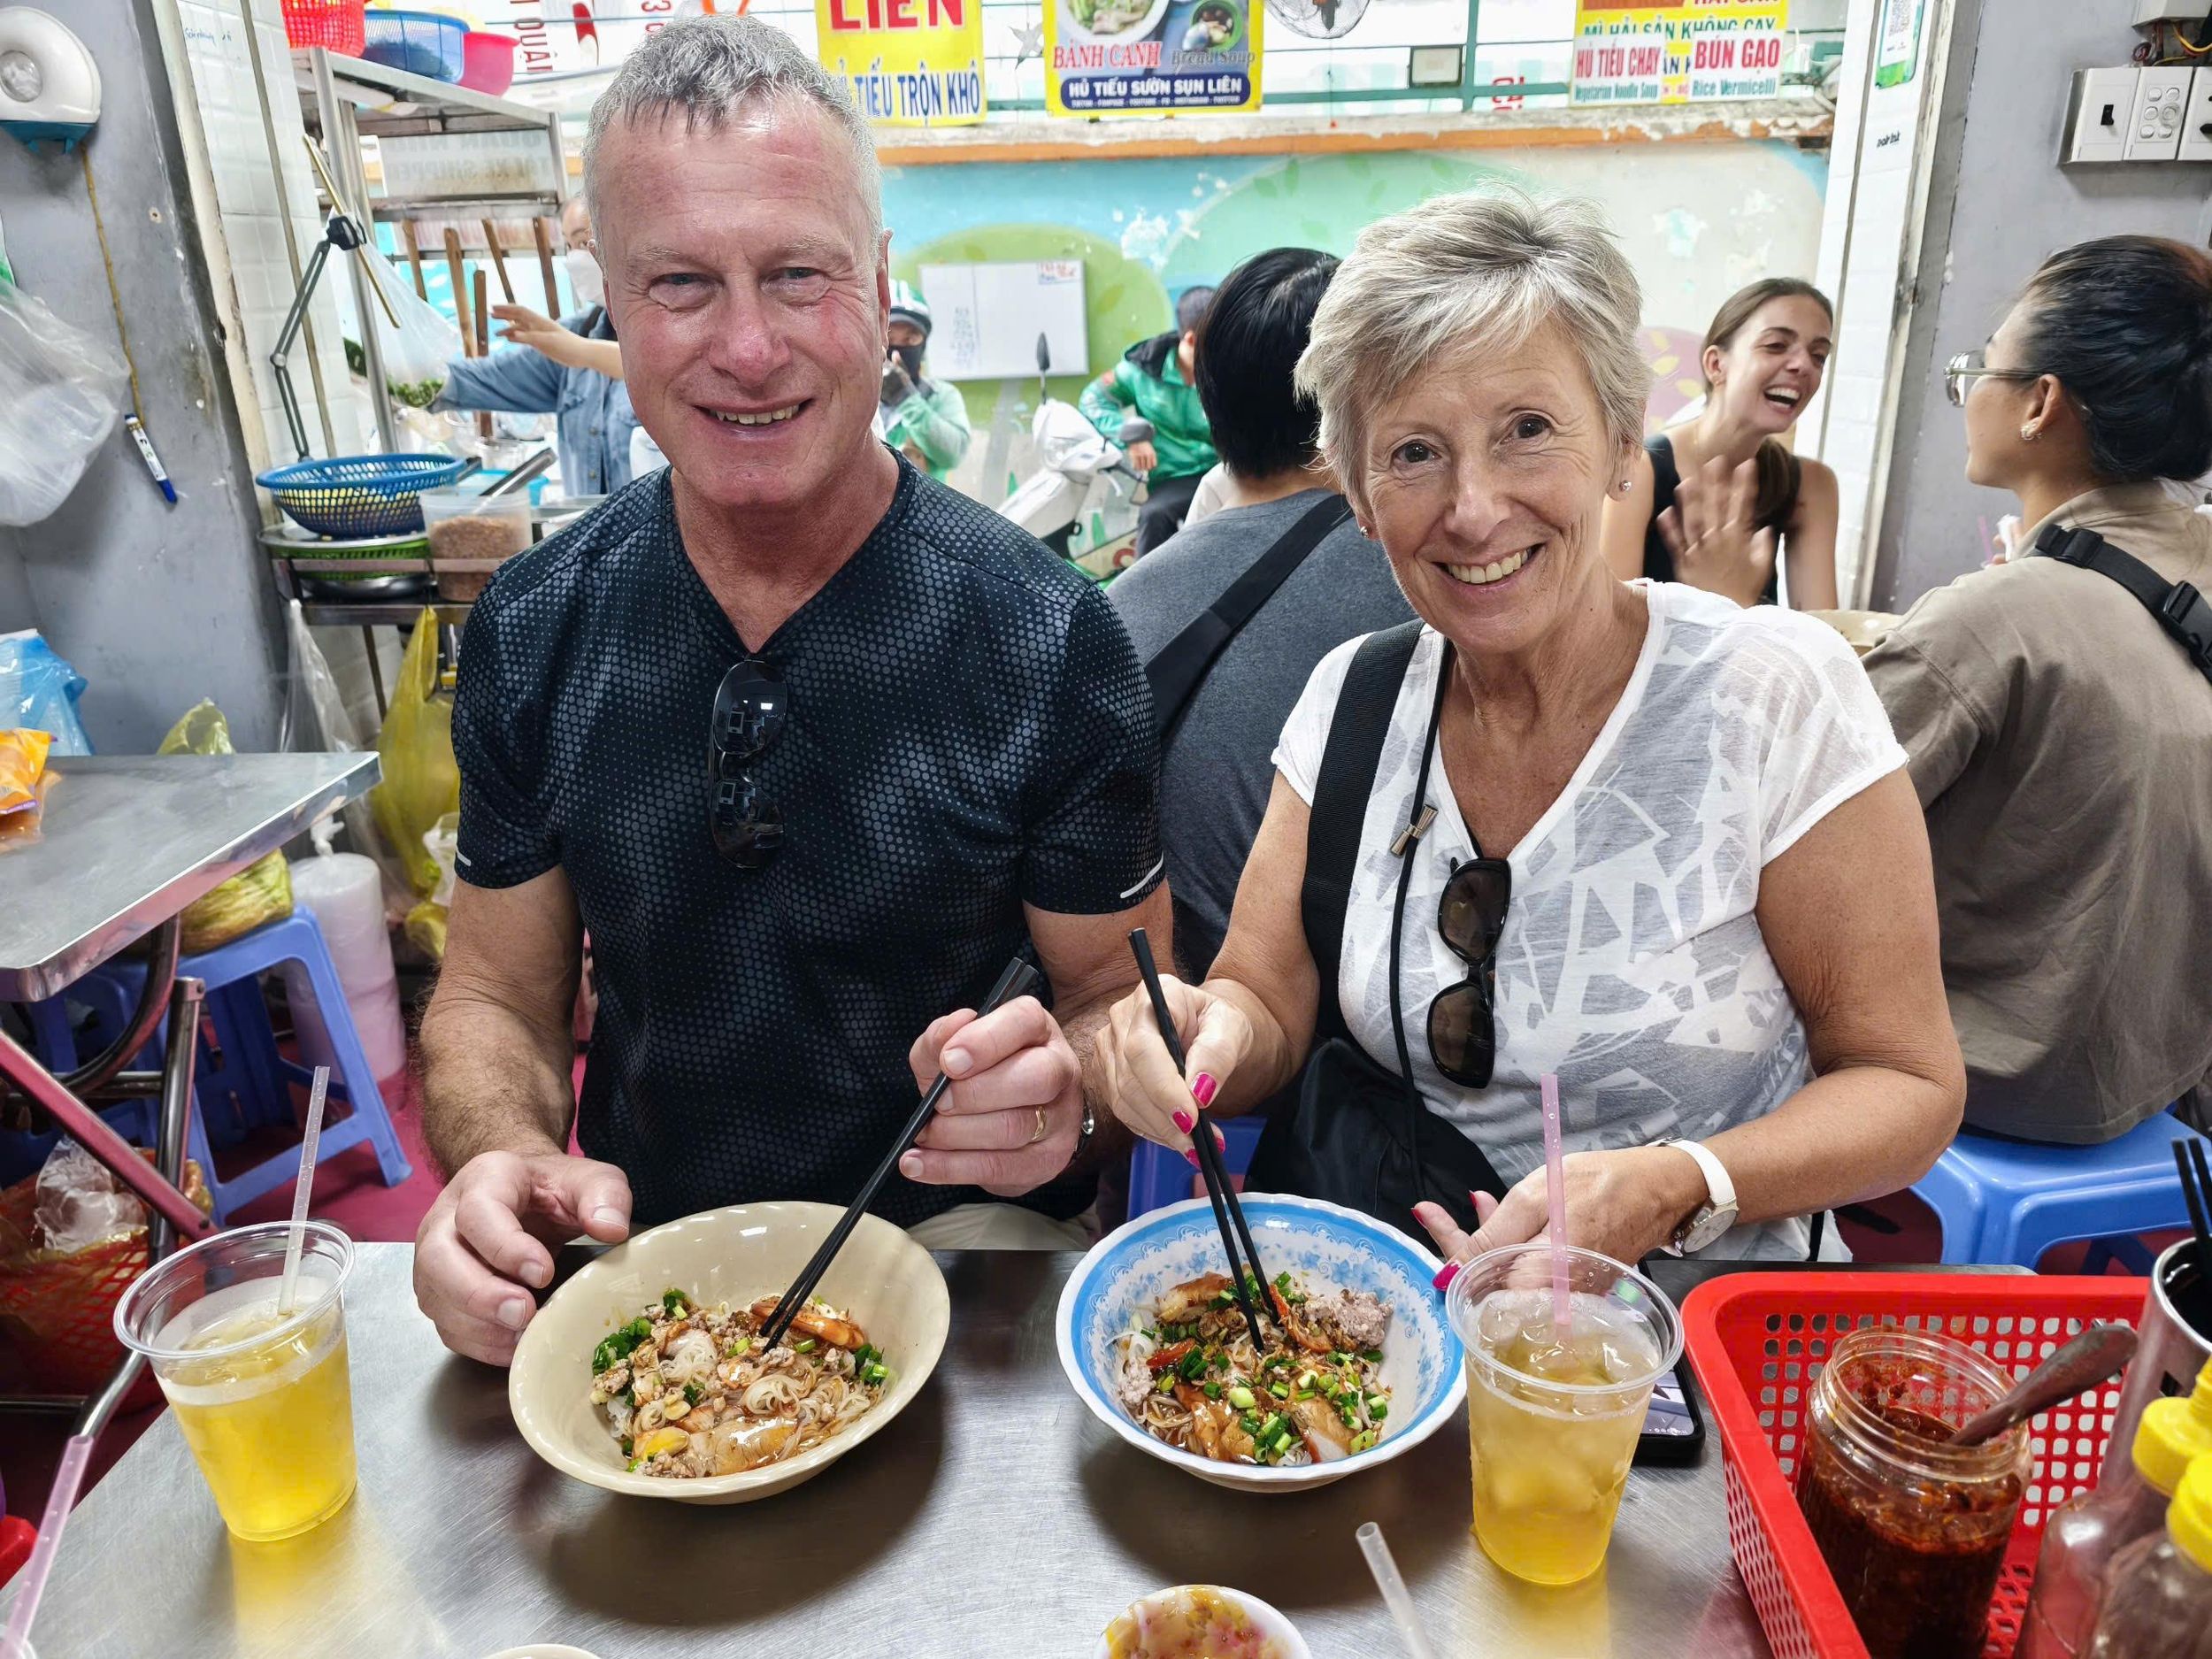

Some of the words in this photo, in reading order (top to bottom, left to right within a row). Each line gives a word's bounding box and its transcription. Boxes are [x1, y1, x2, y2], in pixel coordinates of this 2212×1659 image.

[1110, 42, 1162, 68] CANH
[1217, 50, 1256, 66] Soup
[1629, 46, 1662, 75] CHAY
[1694, 34, 1735, 69] BÚN
[1740, 38, 1781, 74] GẠO
[854, 58, 894, 117] TIẾU
[897, 61, 942, 127] TRỘN
[947, 60, 979, 115] KHÔ
[1069, 77, 1090, 97] HỦ
[1093, 74, 1127, 96] TIẾU
[1207, 75, 1242, 94] LIÊN
[1692, 80, 1717, 96] Rice
[1720, 77, 1776, 96] Vermicelli
